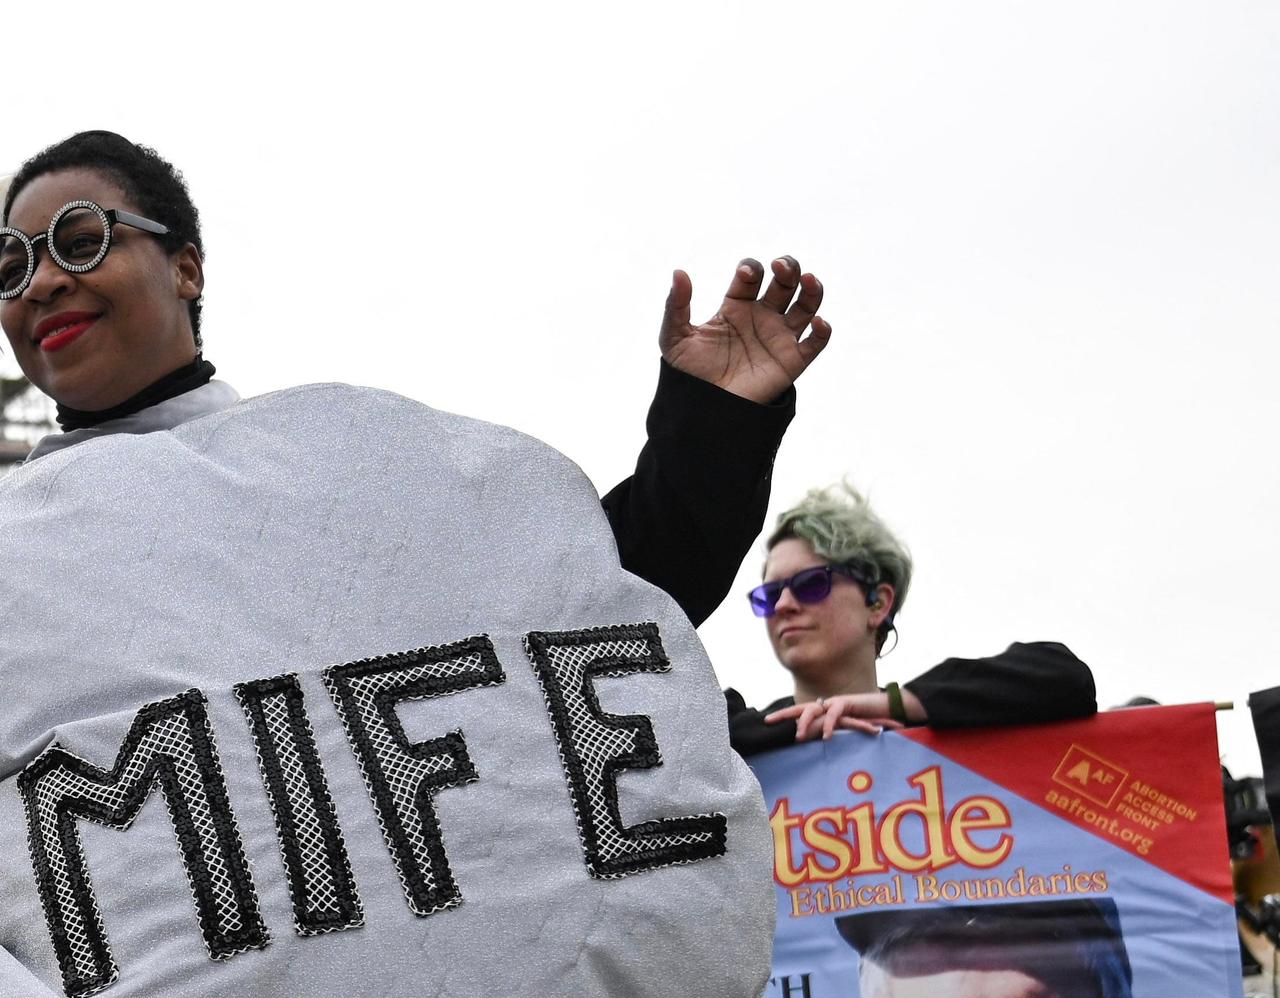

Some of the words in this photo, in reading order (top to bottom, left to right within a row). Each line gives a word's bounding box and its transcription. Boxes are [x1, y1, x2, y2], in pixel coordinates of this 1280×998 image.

[1045, 790, 1154, 855] aafront.org
[1116, 803, 1161, 832] FRONT
[1123, 792, 1175, 824] ACCESS
[1130, 780, 1198, 821] ABORTION
[769, 765, 1014, 888] tside
[787, 874, 905, 917] Ethical
[914, 864, 1109, 904] Boundaries
